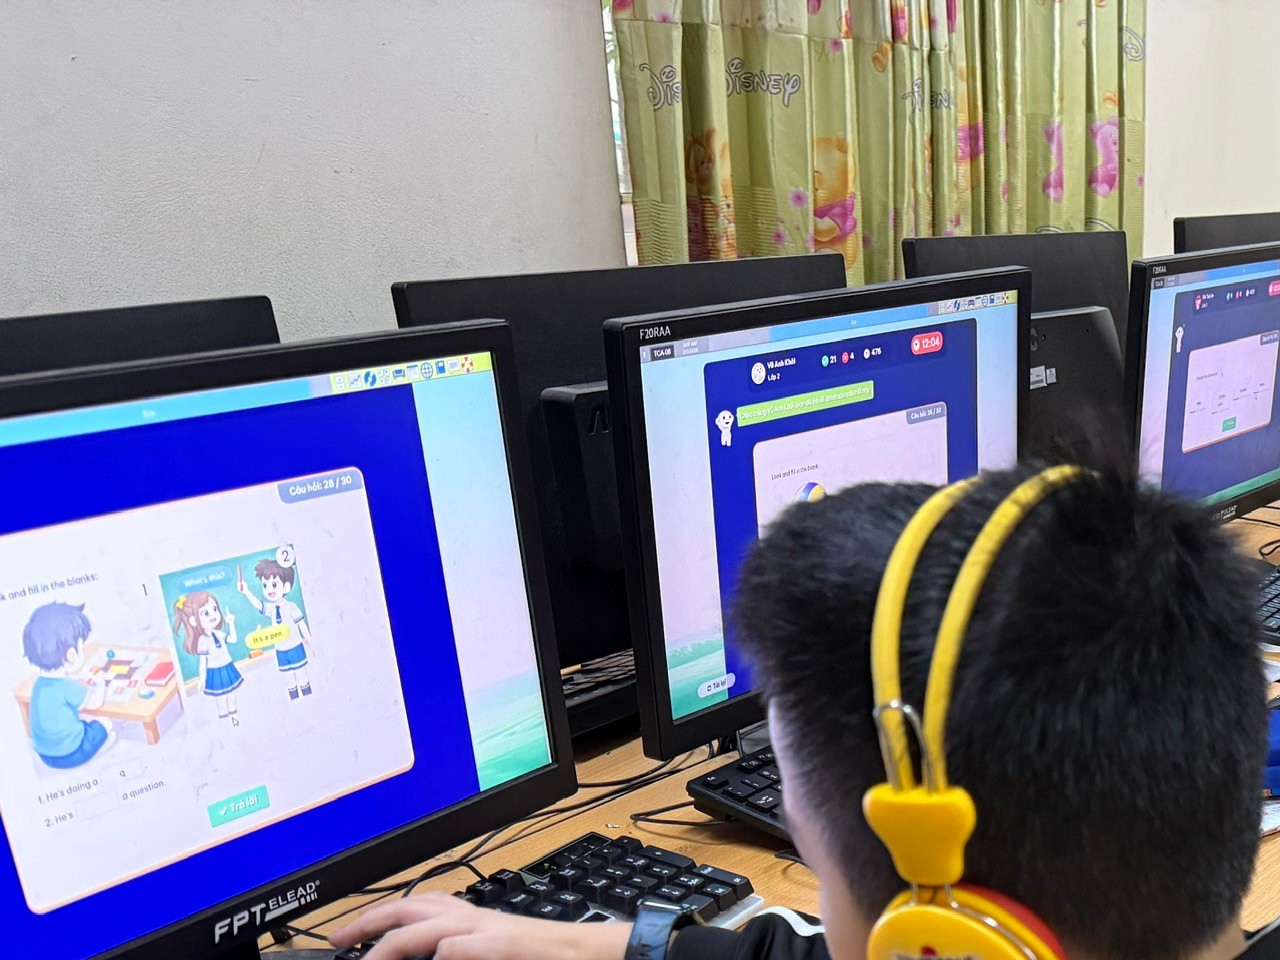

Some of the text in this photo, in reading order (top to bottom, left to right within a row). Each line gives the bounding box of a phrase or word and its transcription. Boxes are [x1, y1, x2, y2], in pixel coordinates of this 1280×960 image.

[640, 325, 671, 340] F20RAA
[921, 336, 940, 349] 12:04
[829, 355, 837, 363] 21
[289, 485, 306, 496] Câu
[323, 479, 335, 490] 28
[340, 475, 352, 485] 30
[281, 550, 290, 562] 2
[8, 588, 26, 600] and
[28, 584, 39, 595] fill
[40, 584, 49, 593] in
[50, 579, 65, 590] the
[66, 572, 98, 586] blanks:
[142, 583, 148, 597] 1
[253, 636, 264, 644] It's
[38, 778, 99, 805] 1. He's doing a
[122, 792, 129, 801] a
[44, 811, 74, 828] 2. He's
[214, 903, 267, 944] FPT
